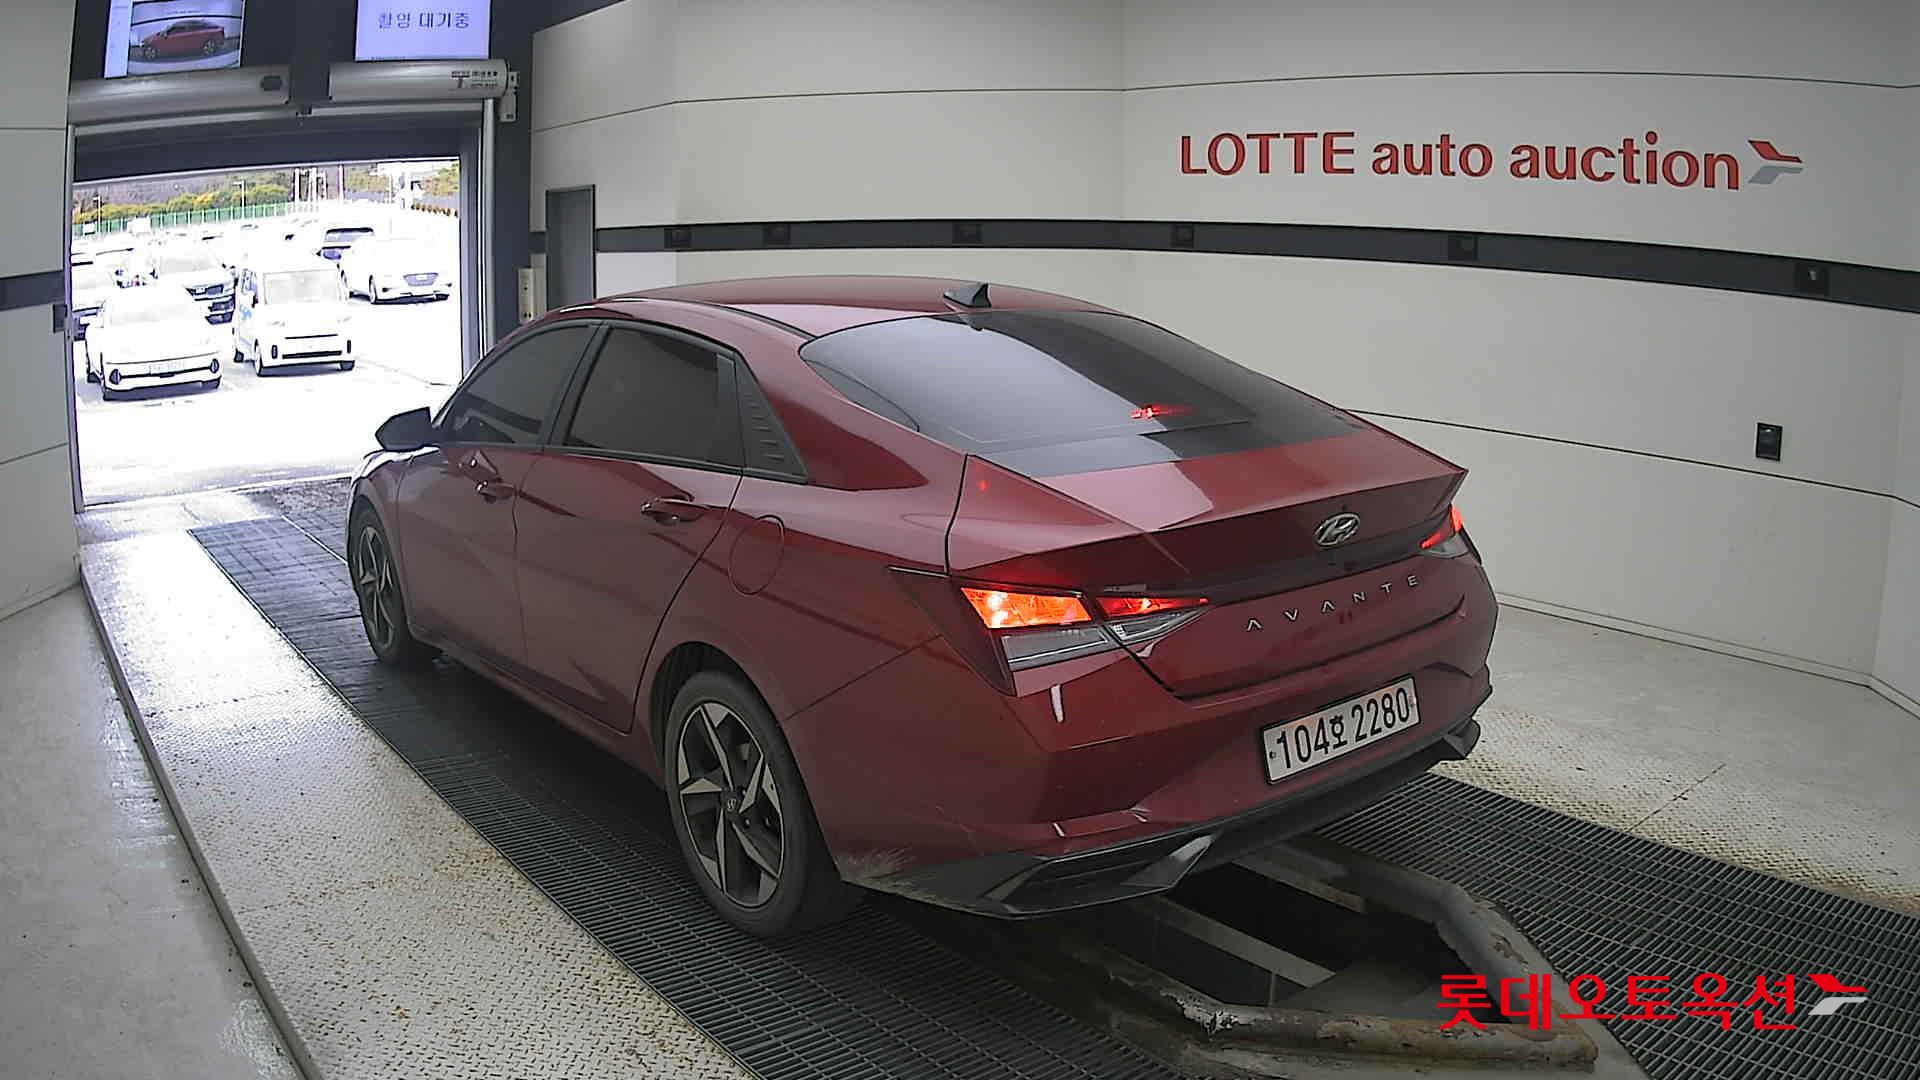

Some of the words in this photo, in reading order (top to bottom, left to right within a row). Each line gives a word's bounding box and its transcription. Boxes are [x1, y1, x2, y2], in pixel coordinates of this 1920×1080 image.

[419, 11, 469, 29] 대기중
[1180, 131, 1355, 175] LOTTE
[1372, 134, 1494, 177] auto
[1509, 130, 1740, 191] auction
[1246, 575, 1420, 632] AVANTE
[1276, 714, 1348, 770] 104호
[1350, 687, 1411, 744] 2280
